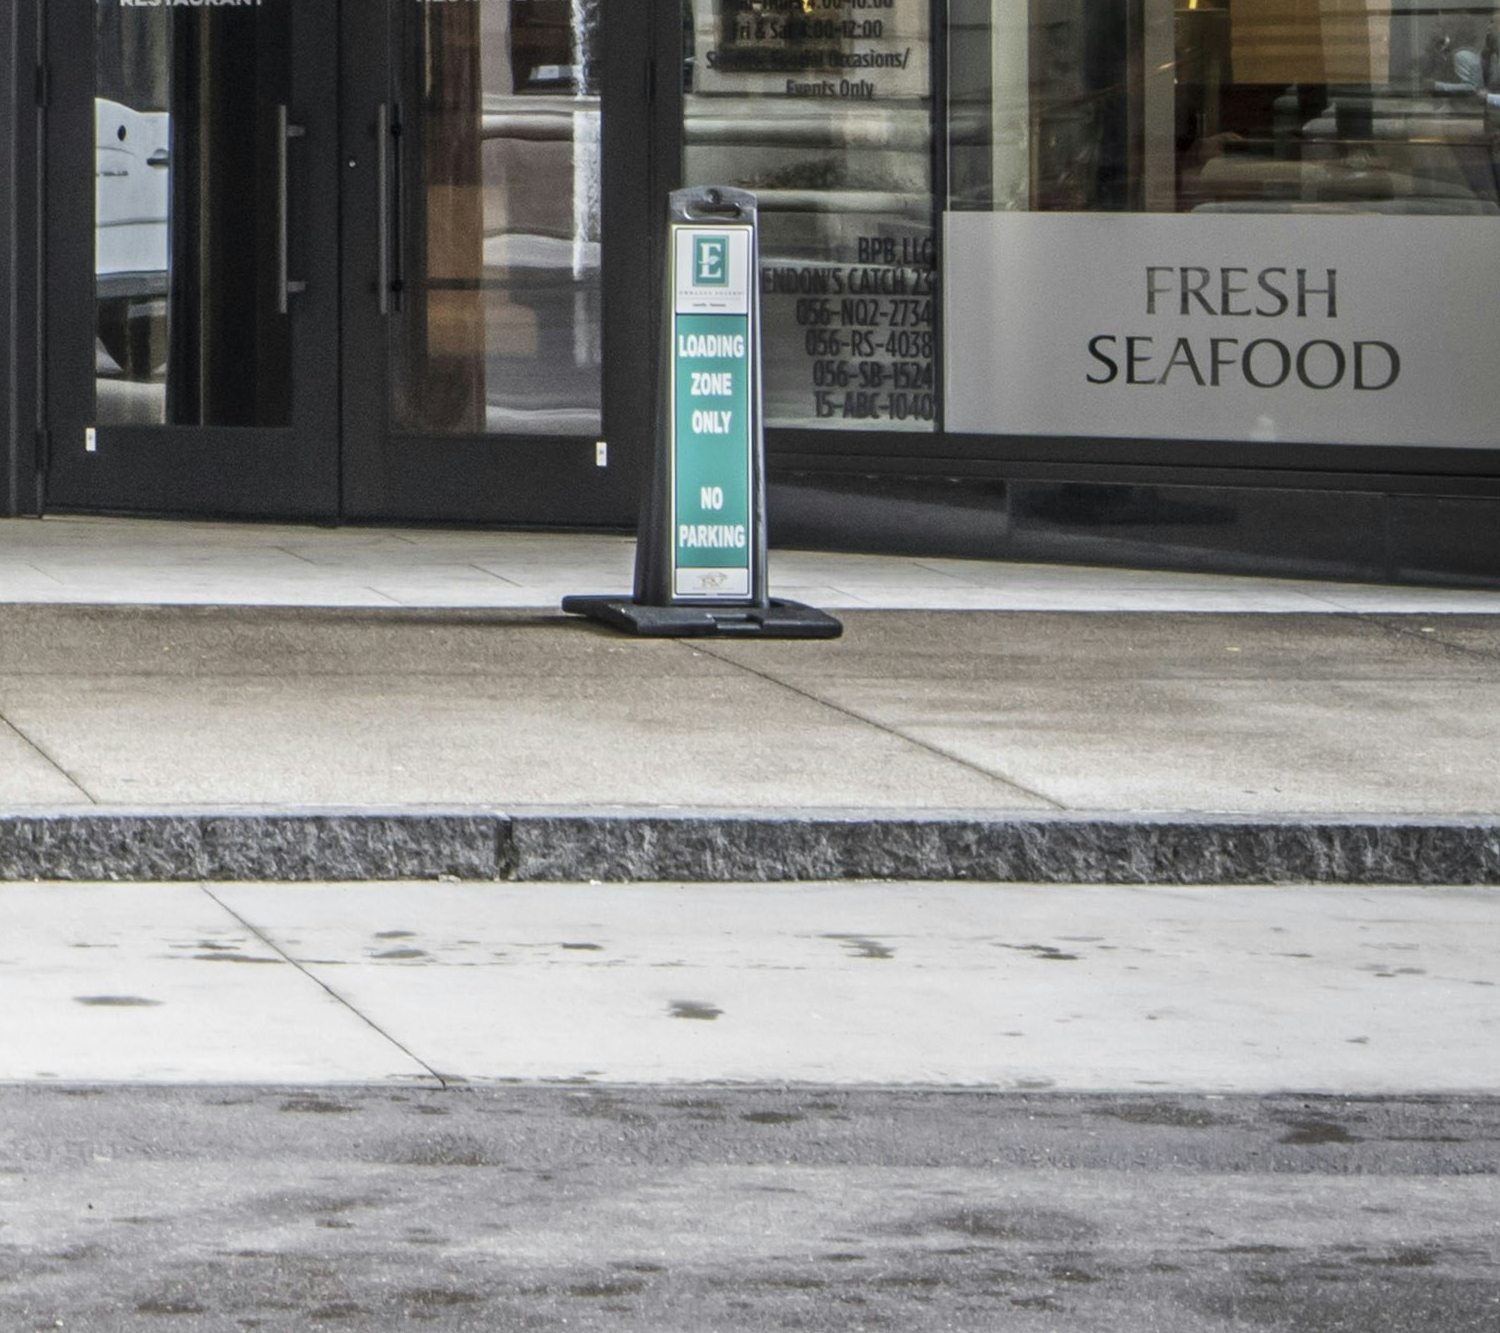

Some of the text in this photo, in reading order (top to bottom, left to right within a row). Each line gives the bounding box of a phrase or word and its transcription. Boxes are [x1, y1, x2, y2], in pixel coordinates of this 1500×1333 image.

[786, 79, 874, 99] Events Only
[762, 267, 843, 295] ENDON'S
[849, 268, 905, 296] CATCH
[1145, 265, 1338, 319] FRESH
[678, 333, 745, 359] LOADING
[1085, 334, 1402, 392] SEAFOOD
[690, 372, 733, 397] ZONE
[691, 410, 732, 435] ONLY
[700, 486, 724, 510] NO
[678, 524, 746, 549] PARKING
